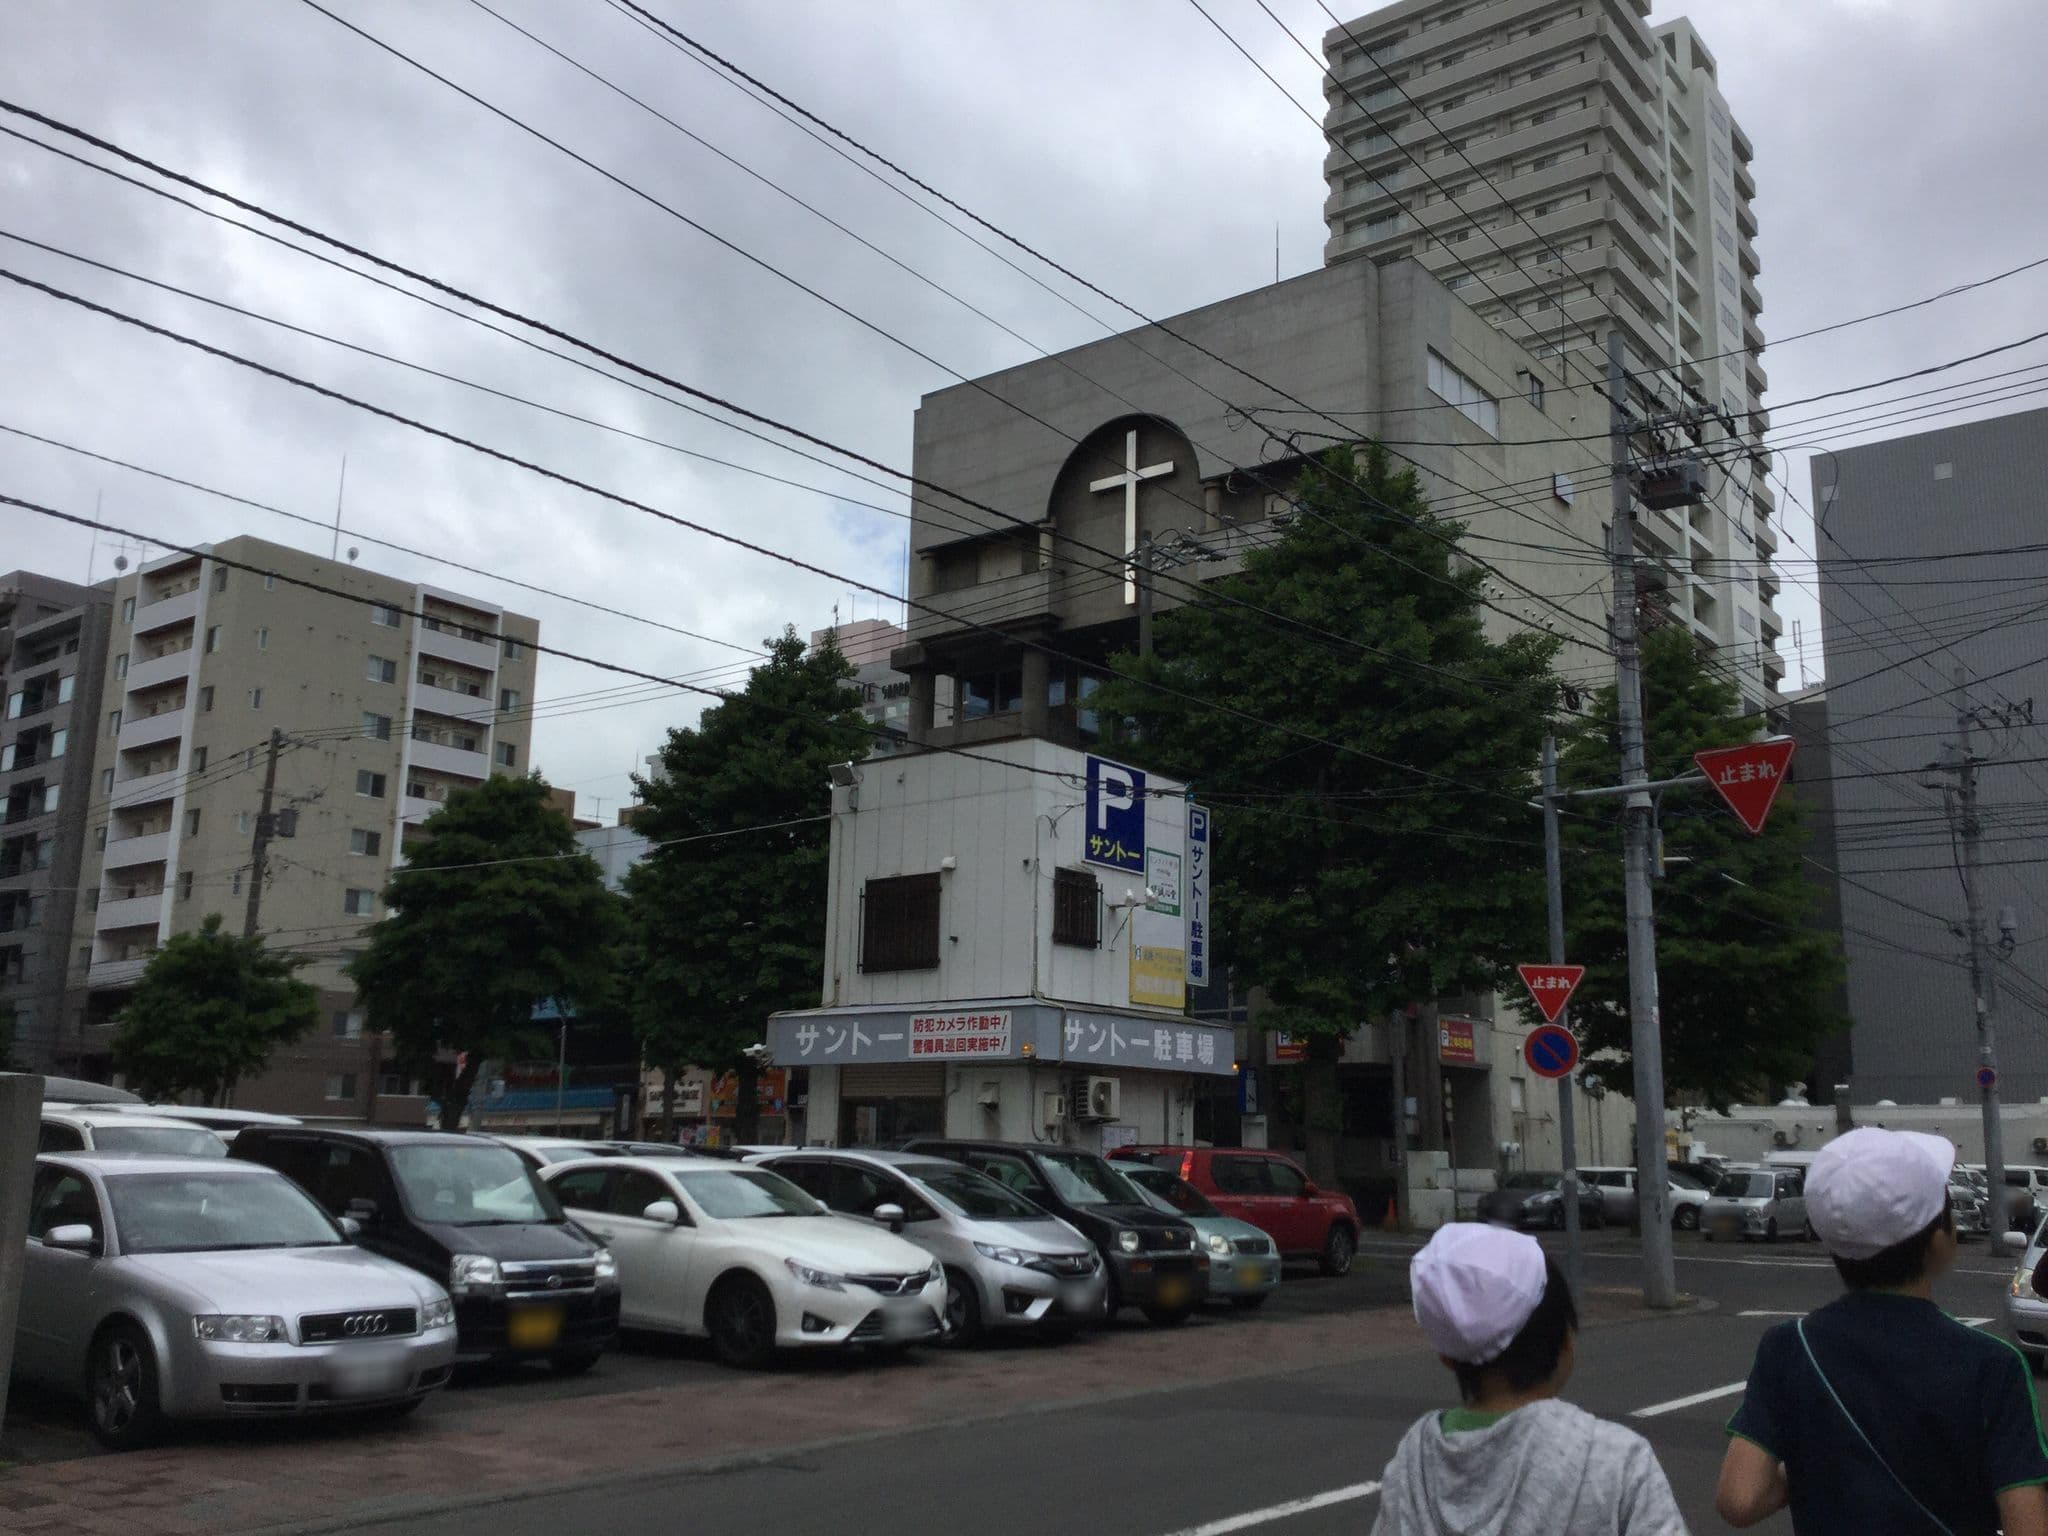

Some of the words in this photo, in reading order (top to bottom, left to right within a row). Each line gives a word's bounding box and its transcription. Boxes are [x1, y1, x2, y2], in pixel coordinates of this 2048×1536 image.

[1719, 760, 1778, 784] 止まれ
[1098, 763, 1134, 830] P
[1191, 813, 1205, 838] P
[1090, 834, 1140, 861] サントー
[1191, 846, 1204, 978] サントー駐車場
[1532, 976, 1571, 989] 止まれ
[913, 1015, 1008, 1032] 防犯カメラ作動中!
[795, 1022, 903, 1056] サントー
[1064, 1018, 1214, 1065] サントー駐車場
